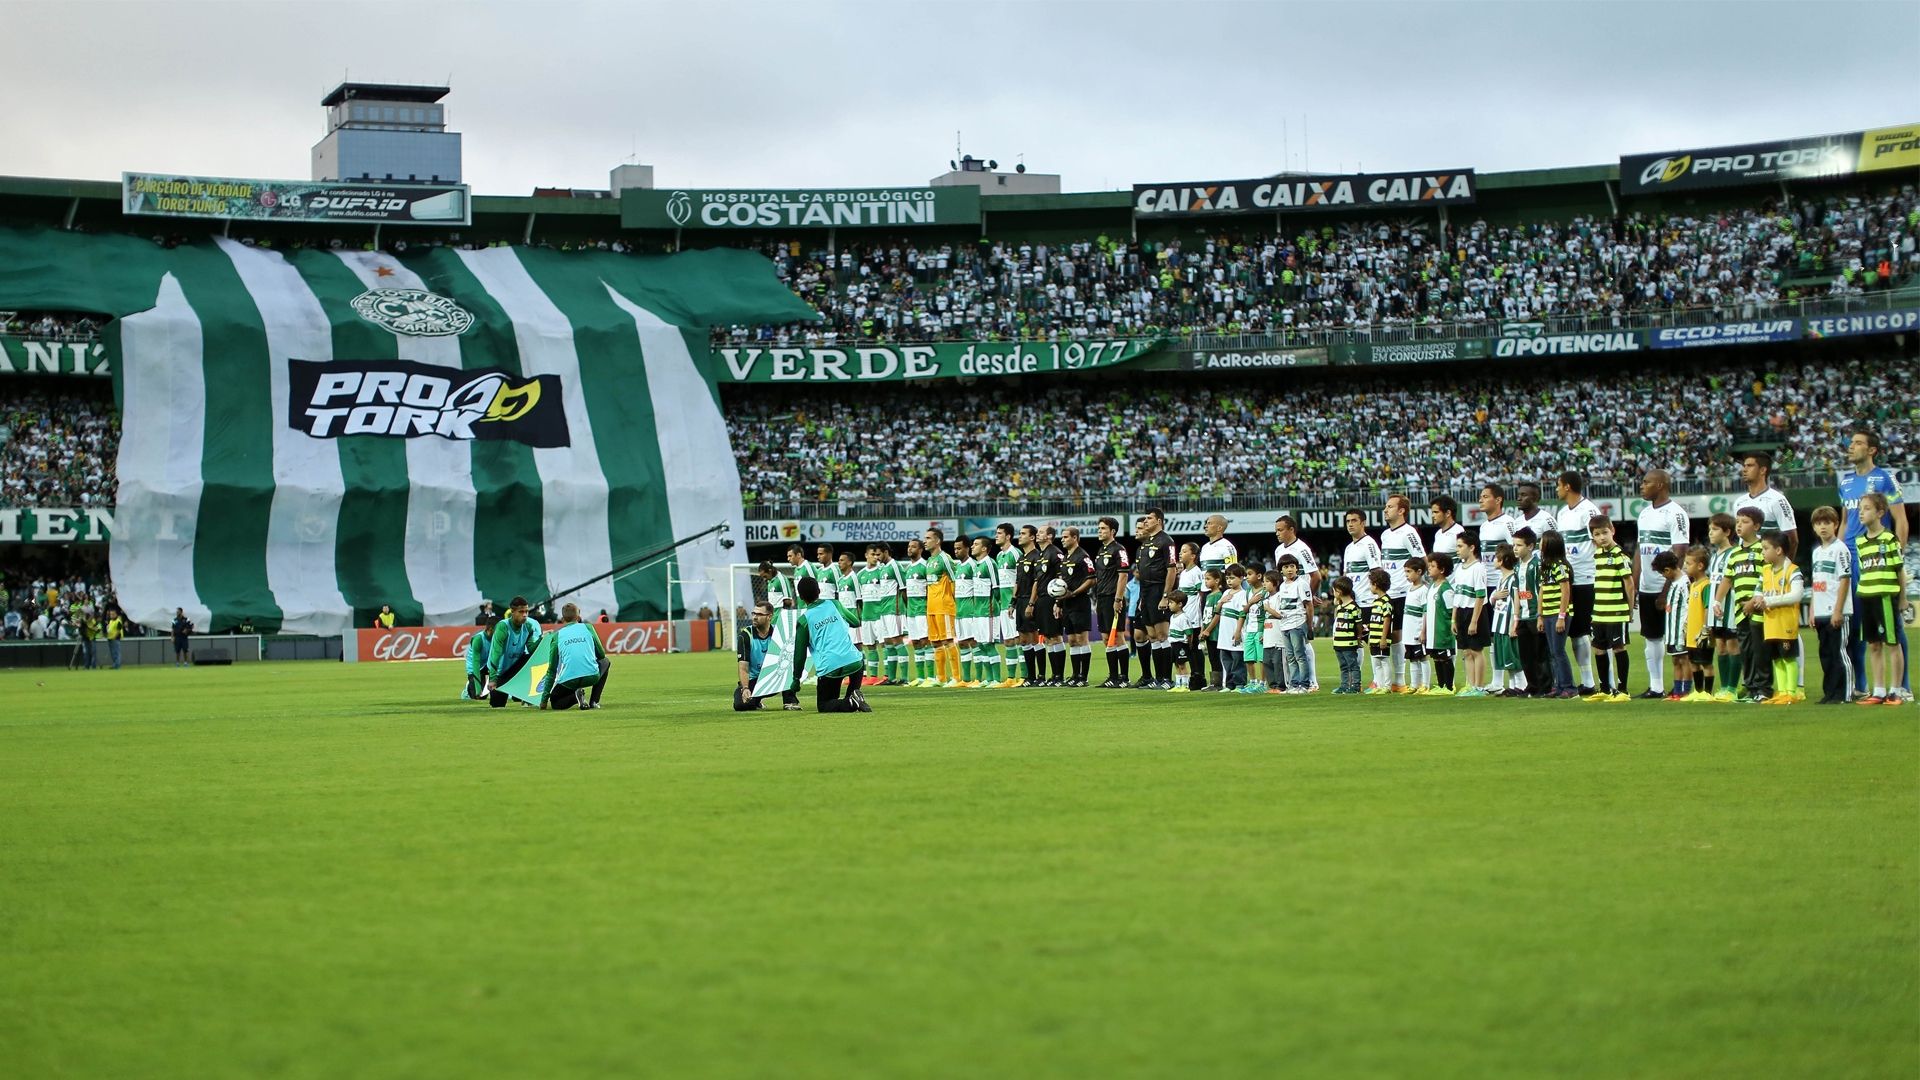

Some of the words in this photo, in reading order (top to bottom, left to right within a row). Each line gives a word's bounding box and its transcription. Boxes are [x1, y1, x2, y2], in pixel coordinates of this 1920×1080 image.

[1692, 154, 1754, 174] PRO
[1760, 145, 1841, 168] TORK
[136, 180, 188, 194] PARCEIRO
[190, 183, 205, 195] DE
[206, 184, 254, 198] VERDADE
[703, 193, 791, 203] HOSPITAL
[798, 190, 936, 203] CARDIOLÓGICO
[1137, 186, 1239, 213] CAIXA
[1252, 181, 1355, 207] CAIXA
[1368, 175, 1471, 202] CAIXA
[156, 196, 191, 211] TORCE
[192, 199, 226, 213] JUNTO
[280, 195, 301, 207] LG
[701, 200, 936, 227] COSTANTINI
[1371, 343, 1421, 354] TRANSFORME
[1422, 342, 1457, 352] IMPOSTO
[1516, 333, 1640, 356] POTENCIAL
[720, 345, 940, 380] VERDE
[958, 343, 1037, 374] desde
[1050, 341, 1128, 369] 1977
[1207, 352, 1297, 368] AdRockers
[1372, 353, 1388, 362] EM
[310, 371, 451, 409] PRO
[305, 406, 484, 440] TORK
[831, 521, 896, 532] FORMANDO
[845, 531, 921, 541] PENSADORES
[814, 615, 839, 631] GANDULA
[564, 637, 587, 646] GANDULA
